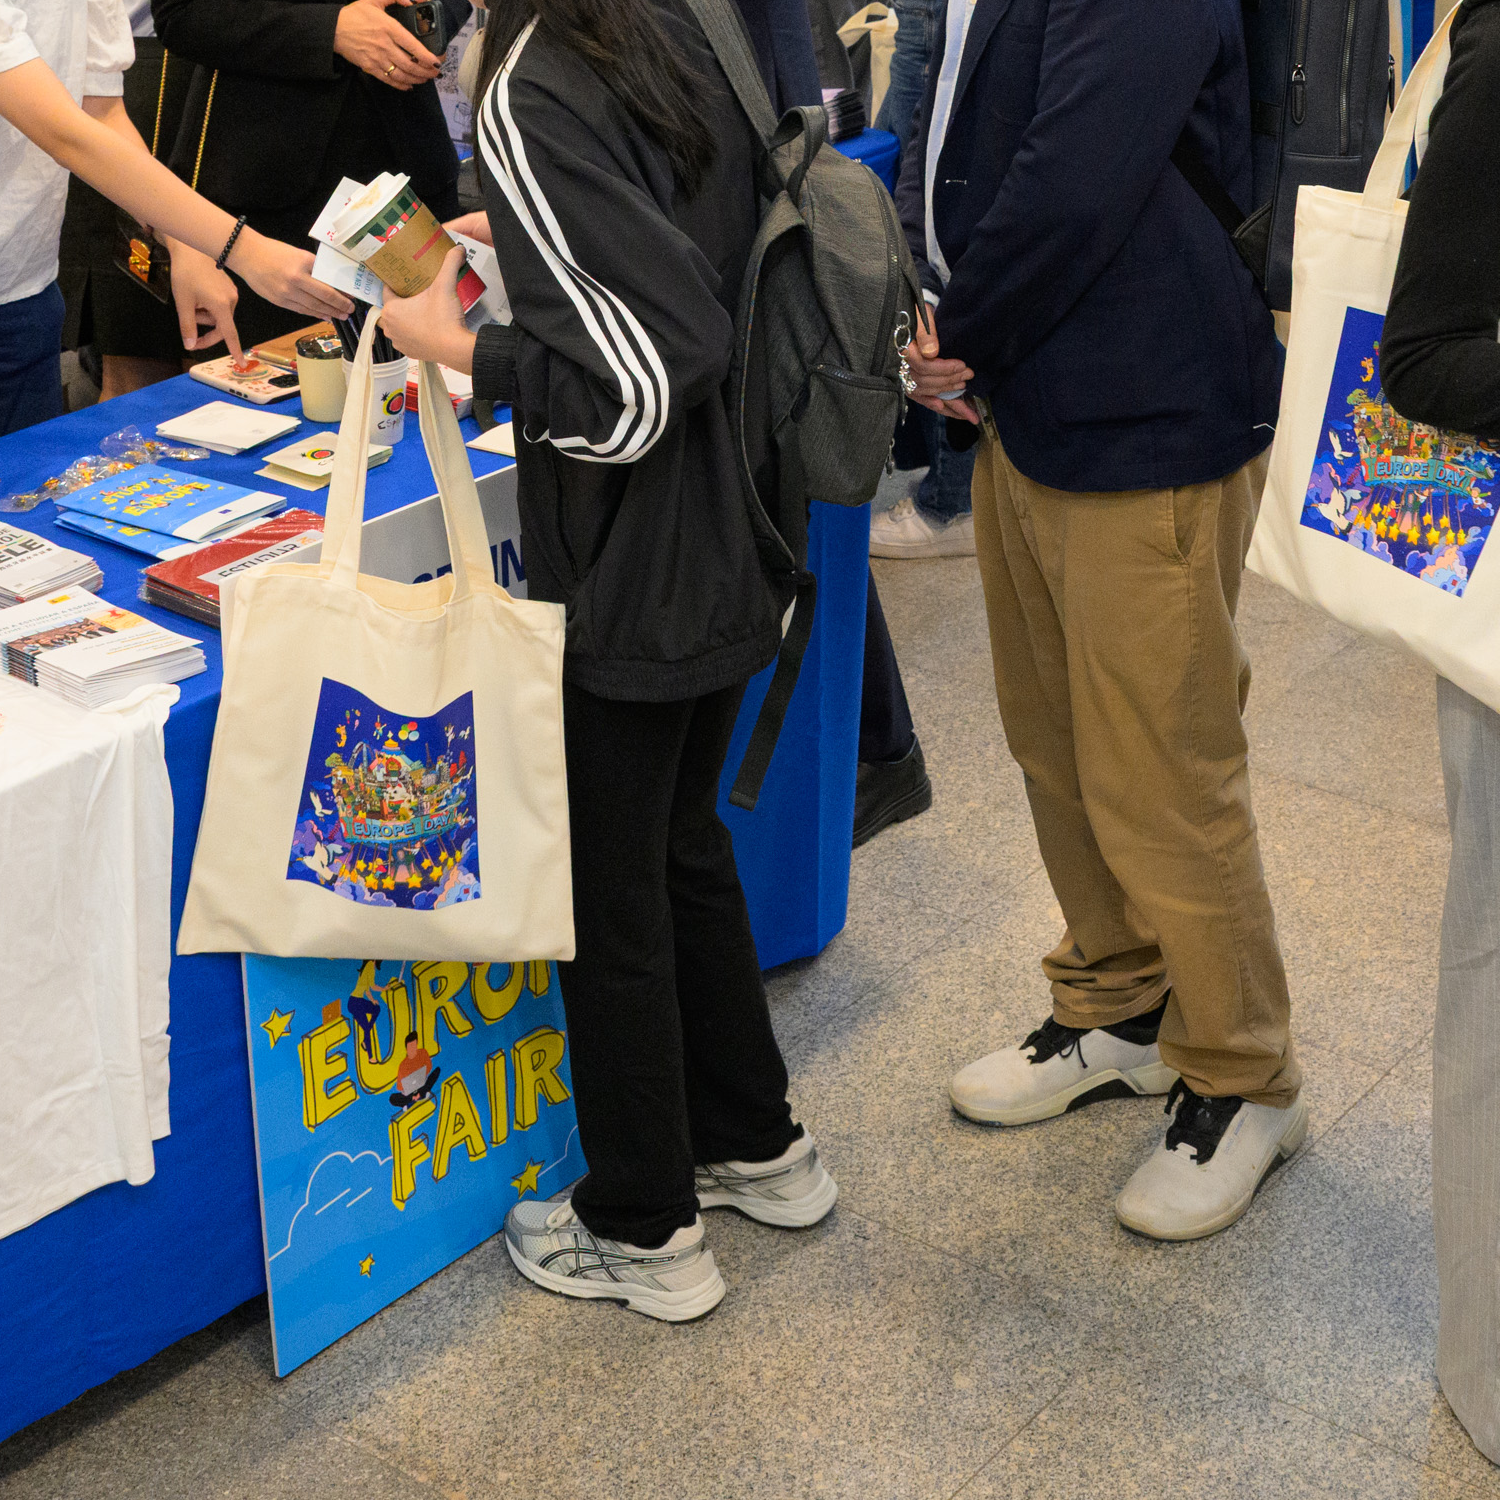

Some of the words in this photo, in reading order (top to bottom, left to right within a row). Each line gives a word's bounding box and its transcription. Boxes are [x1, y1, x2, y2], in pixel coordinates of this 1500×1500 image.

[1376, 461, 1429, 477] EUROPE
[1436, 466, 1466, 487] DAY
[102, 480, 151, 506] STUDY
[122, 480, 211, 517] EUROPE
[353, 821, 416, 838] EUROPE
[423, 812, 452, 831] DAY
[389, 1026, 572, 1210] FAIR
